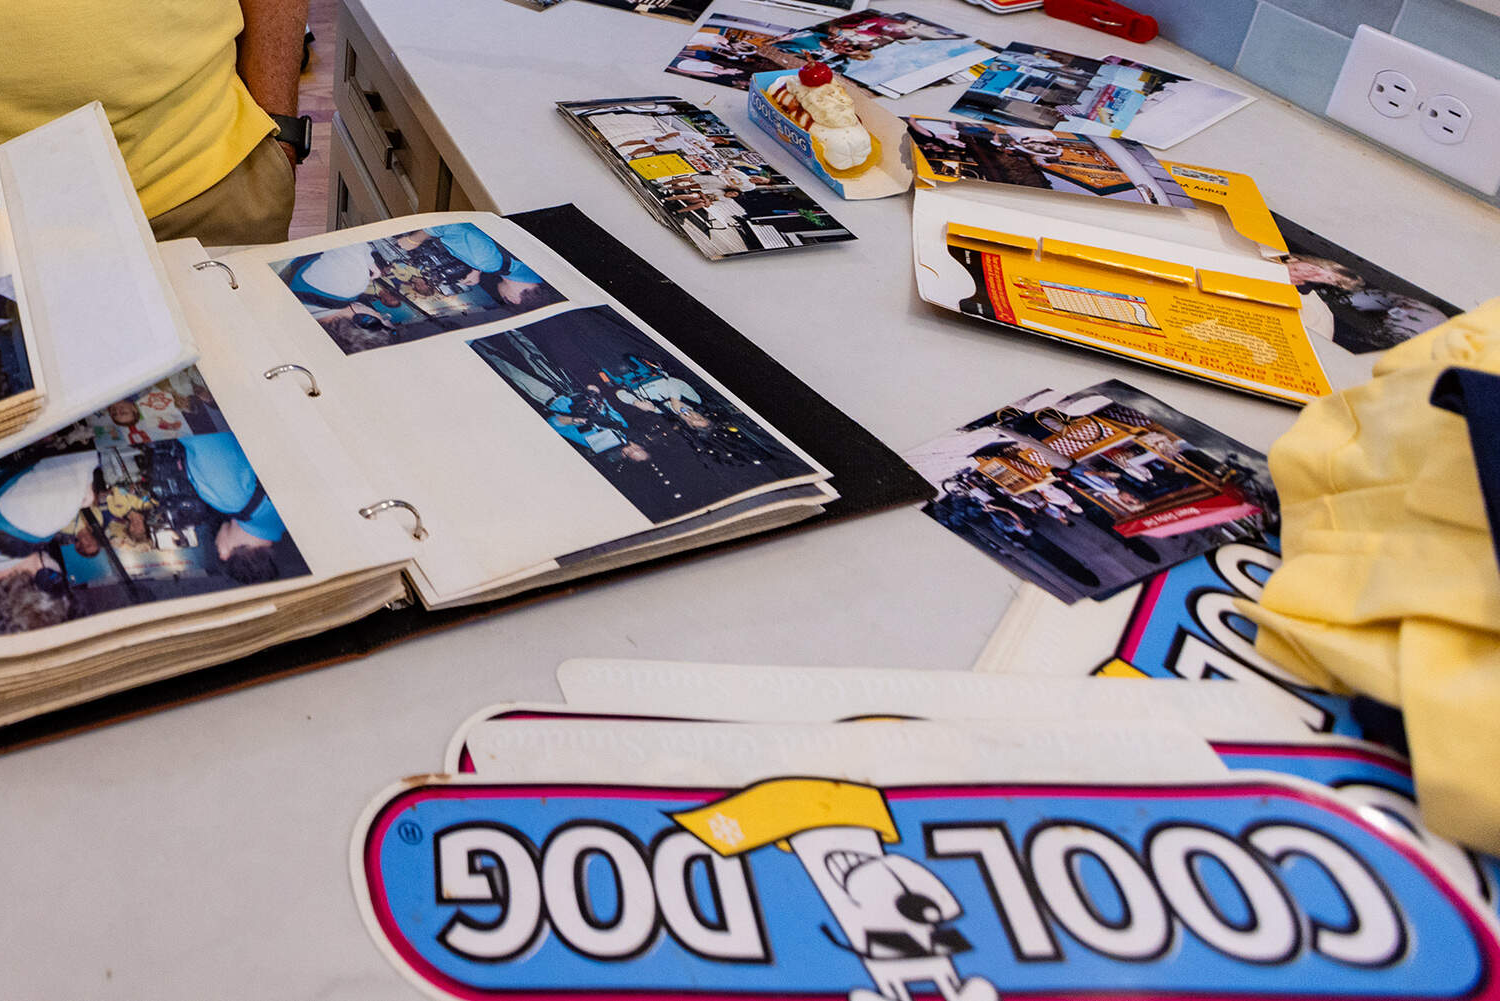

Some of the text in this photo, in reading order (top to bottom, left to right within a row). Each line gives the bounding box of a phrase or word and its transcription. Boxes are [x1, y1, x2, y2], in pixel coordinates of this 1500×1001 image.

[751, 90, 774, 123] COOL
[781, 125, 808, 152] DOG
[432, 818, 774, 965] DOG
[921, 816, 1410, 971] COOL
